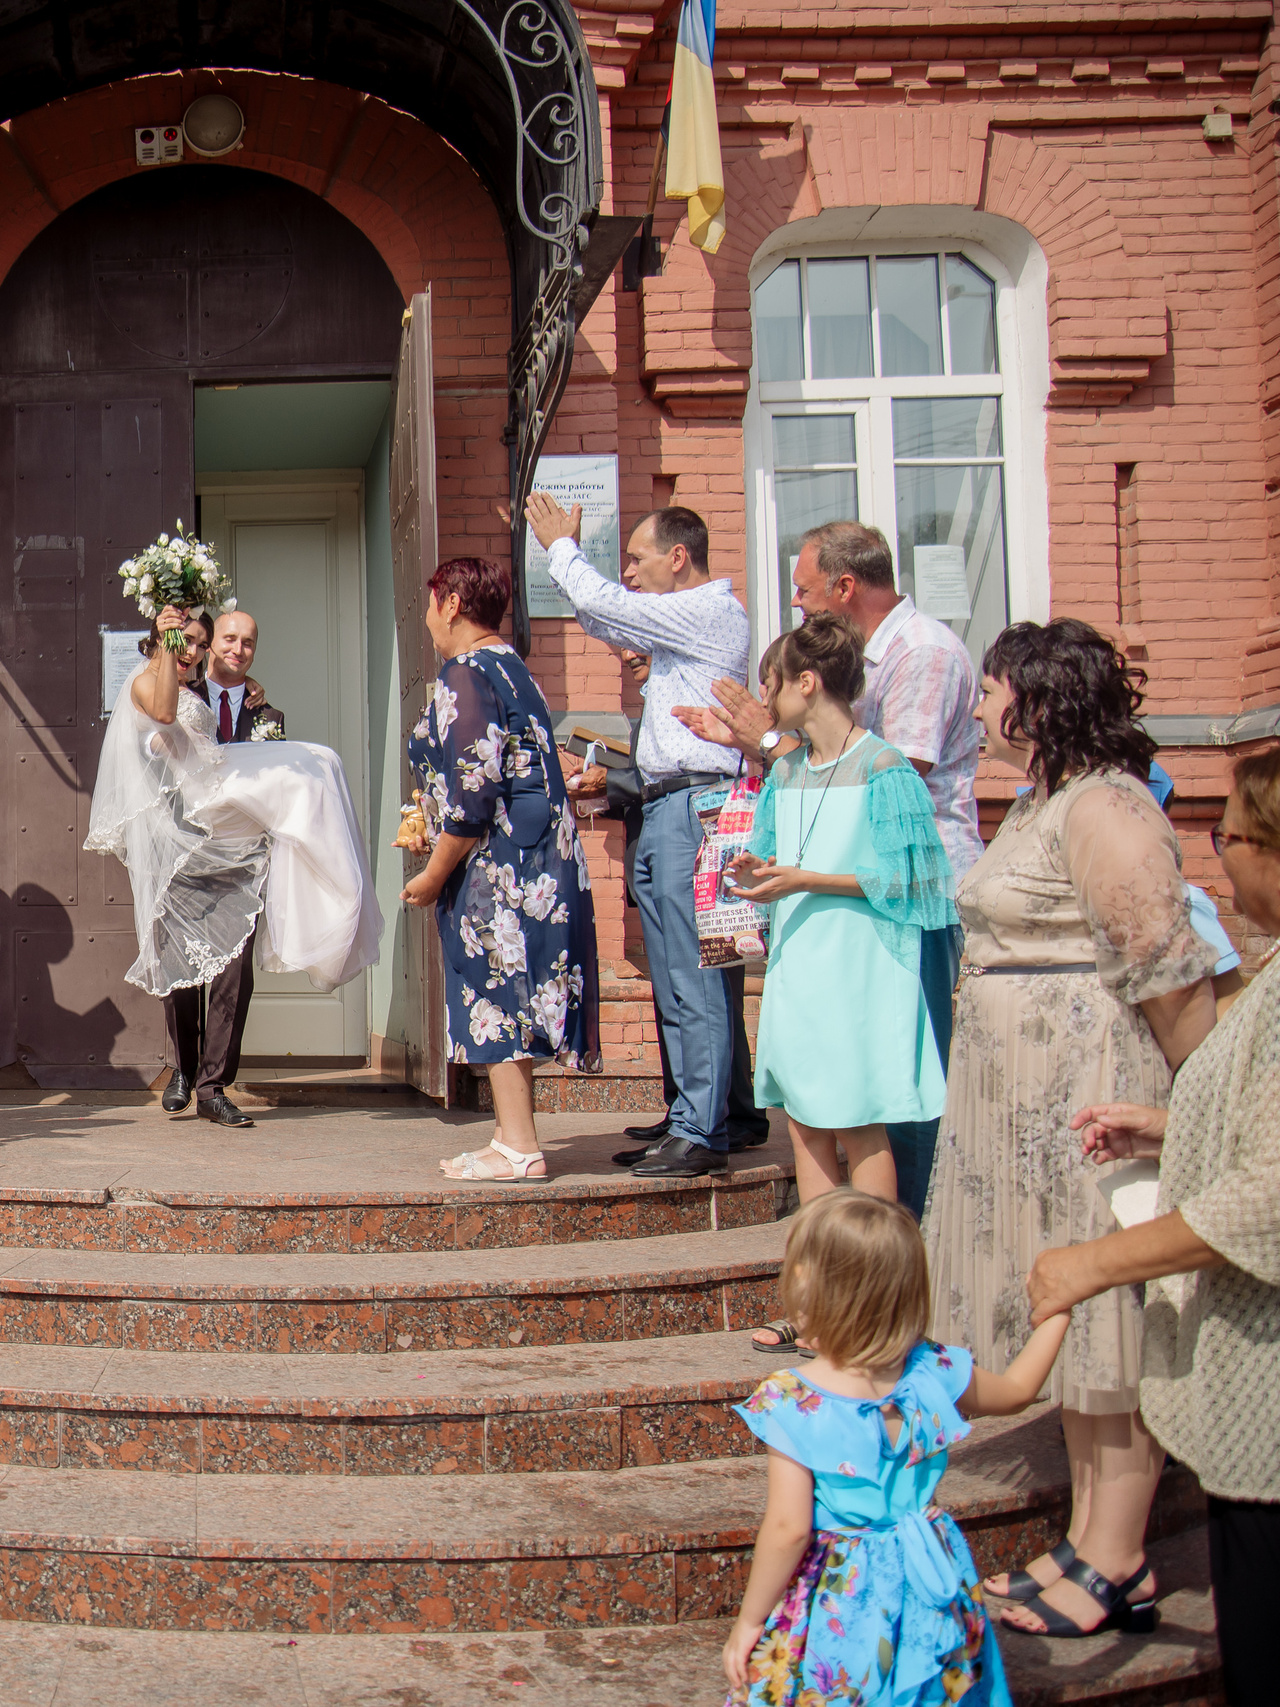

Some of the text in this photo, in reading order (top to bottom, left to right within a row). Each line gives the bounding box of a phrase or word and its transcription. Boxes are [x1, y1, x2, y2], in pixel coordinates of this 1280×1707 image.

[533, 481, 604, 492] Режим работы
[696, 882, 710, 890] CALM
[712, 907, 748, 918] EXPRESSES
[738, 915, 754, 923] INTO
[724, 924, 749, 933] CANNOT
